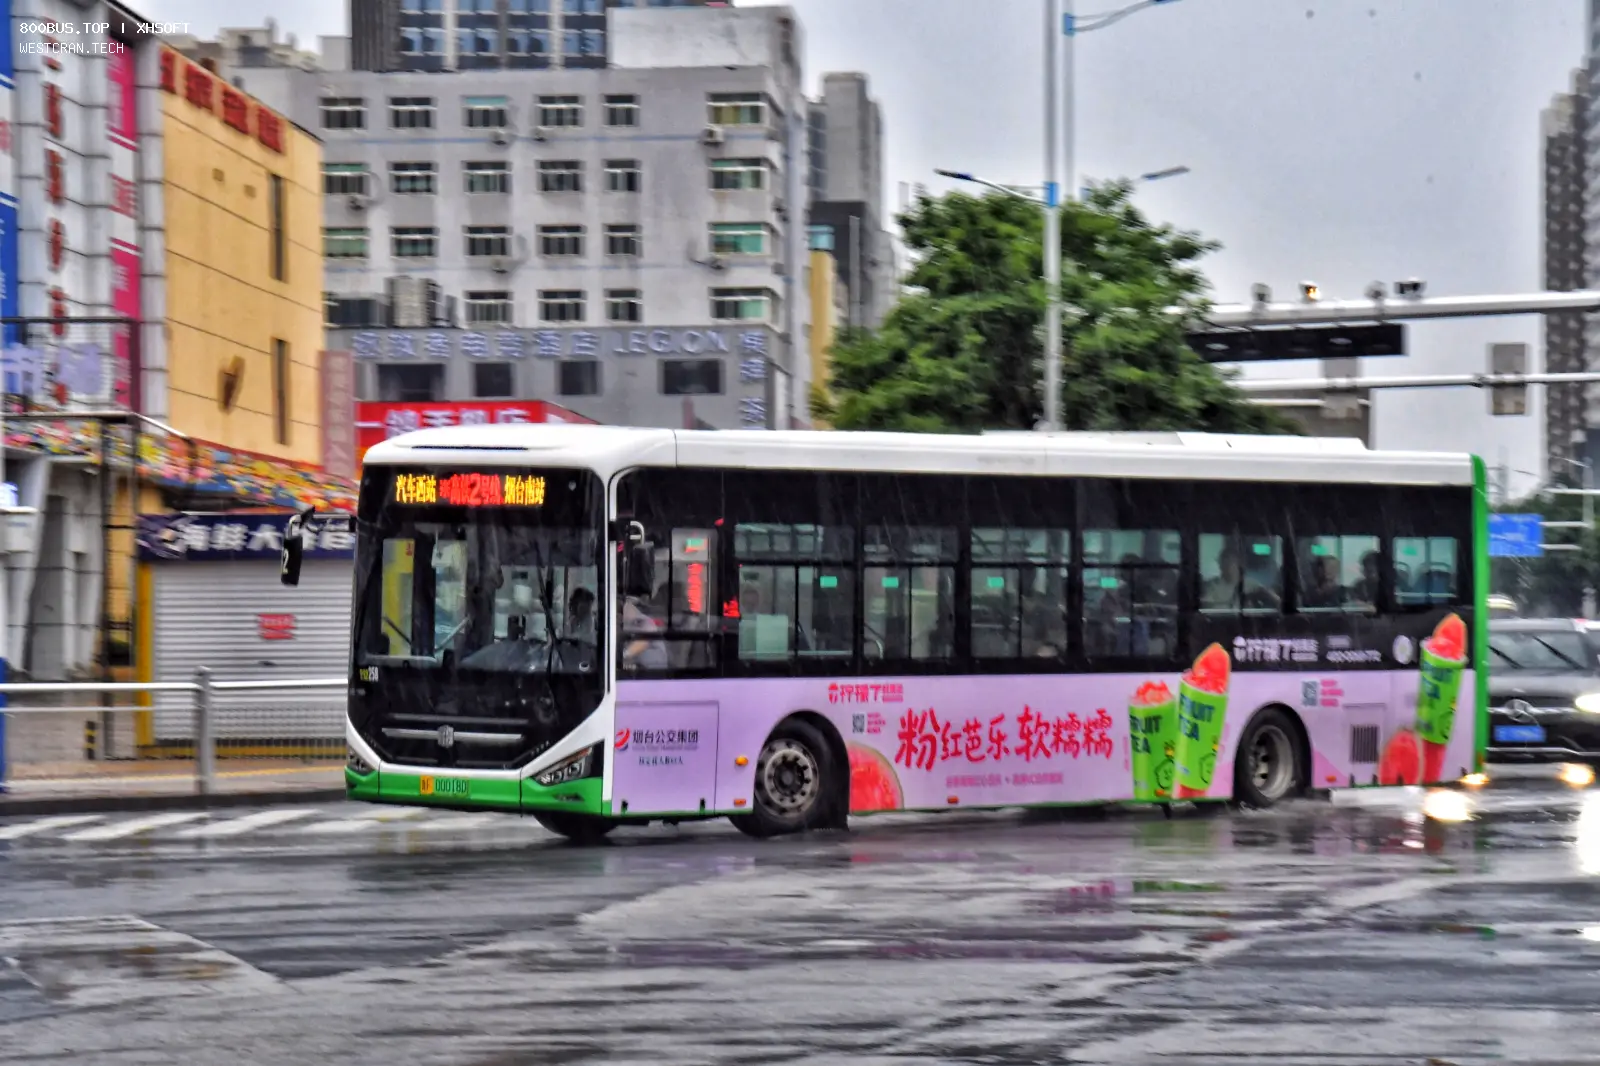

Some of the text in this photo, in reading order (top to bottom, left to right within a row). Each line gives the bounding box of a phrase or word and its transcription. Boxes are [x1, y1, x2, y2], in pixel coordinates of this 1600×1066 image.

[632, 729, 699, 744] 烟台公交集团
